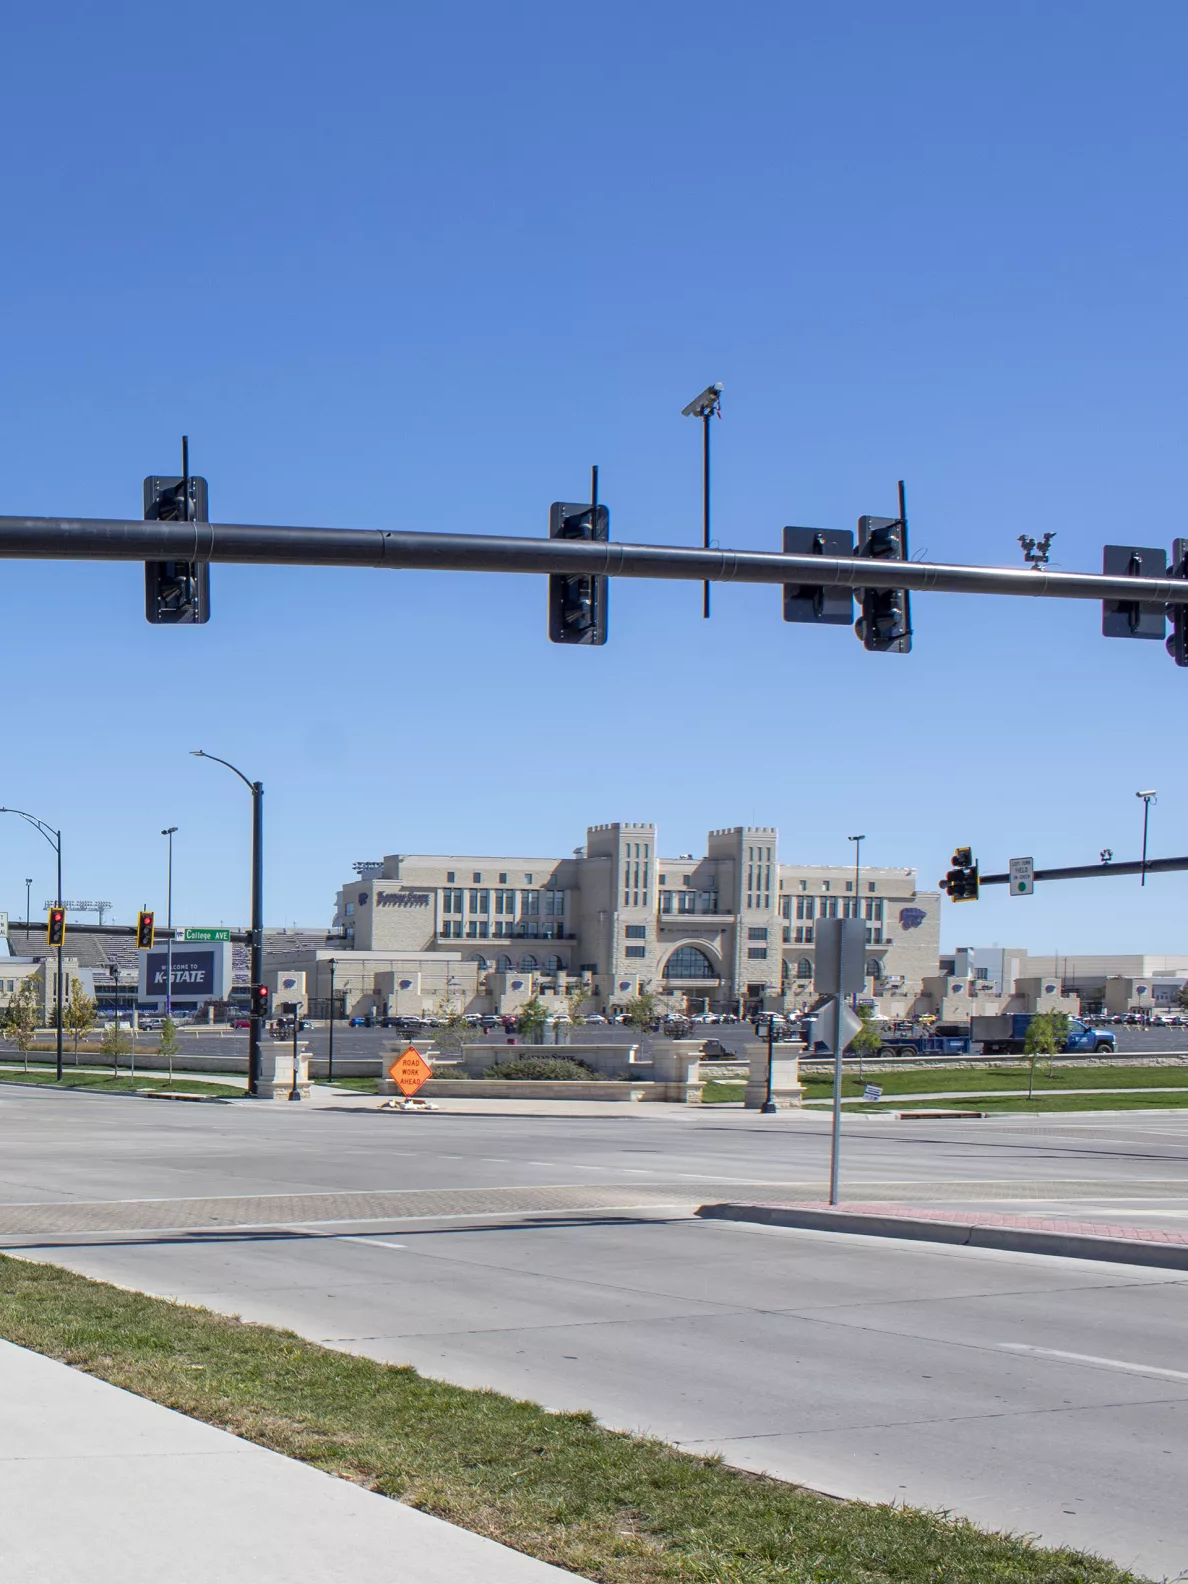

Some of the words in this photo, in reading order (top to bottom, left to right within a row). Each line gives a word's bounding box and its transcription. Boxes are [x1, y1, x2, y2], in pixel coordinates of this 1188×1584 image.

[186, 930, 211, 940] College
[215, 932, 228, 940] AVE
[154, 970, 206, 983] K-STATE
[402, 1059, 420, 1067] ROAD
